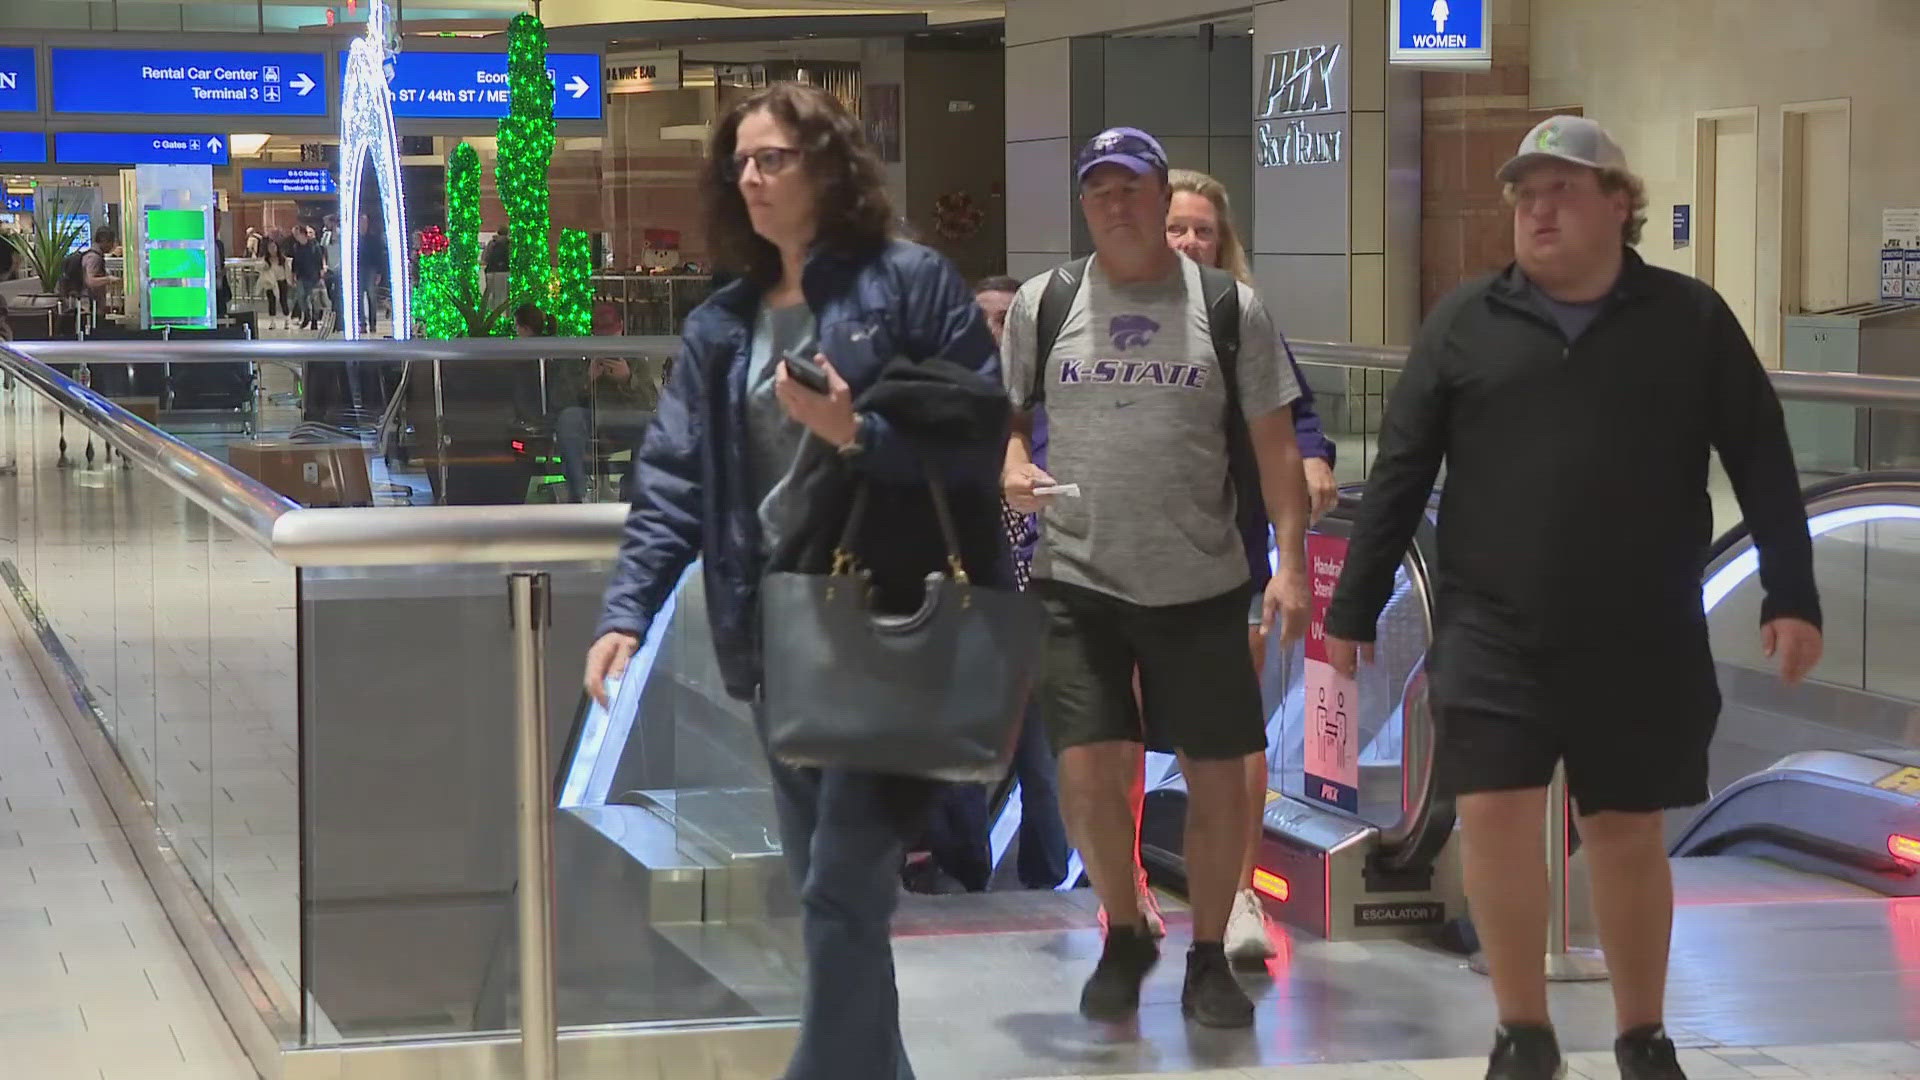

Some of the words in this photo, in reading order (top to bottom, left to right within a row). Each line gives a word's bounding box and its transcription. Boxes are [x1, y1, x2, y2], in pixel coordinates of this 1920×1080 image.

[1412, 34, 1466, 48] WOMEN
[142, 66, 184, 79] Rental
[187, 67, 212, 80] Car
[214, 68, 258, 80] Center
[476, 71, 508, 83] Econ
[639, 65, 656, 79] BAR
[192, 87, 246, 100] Terminal
[249, 87, 259, 100] 3
[399, 89, 417, 102] ST
[427, 90, 456, 103] 44th
[457, 90, 476, 103] ST
[153, 140, 160, 149] C
[162, 140, 187, 149] Gates
[1060, 358, 1208, 389] K-STATE
[1362, 908, 1428, 920] ESCALATOR
